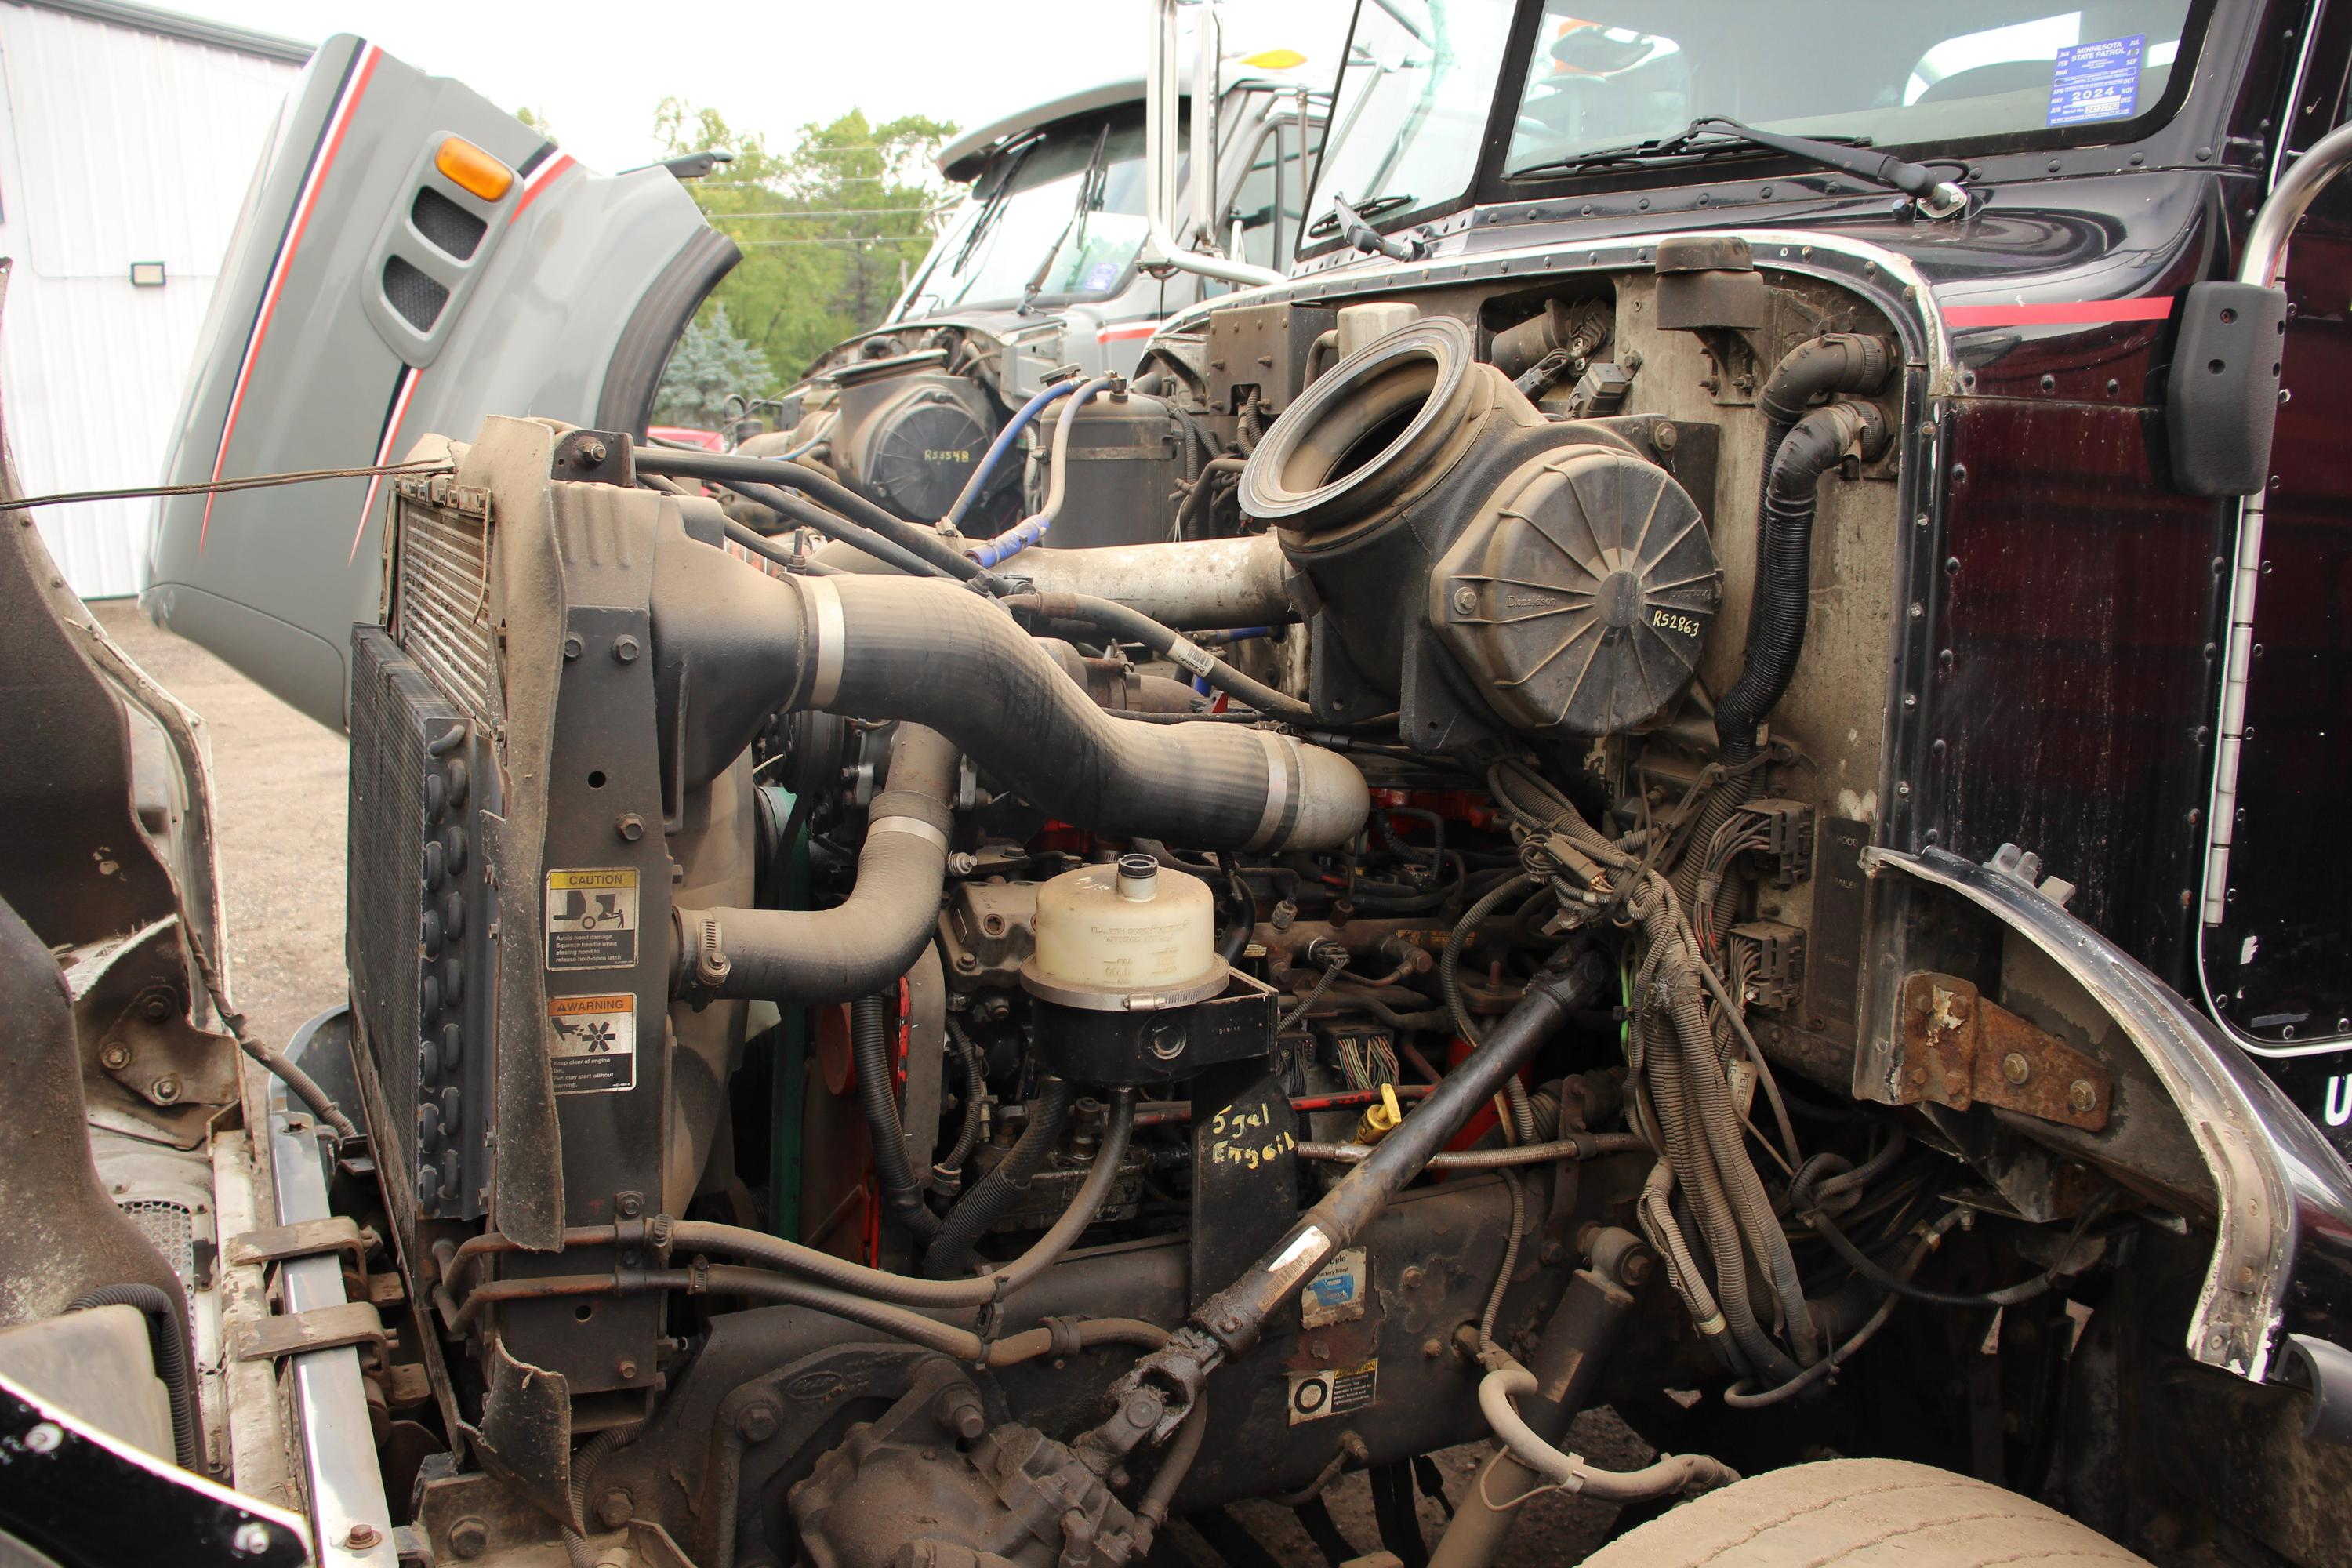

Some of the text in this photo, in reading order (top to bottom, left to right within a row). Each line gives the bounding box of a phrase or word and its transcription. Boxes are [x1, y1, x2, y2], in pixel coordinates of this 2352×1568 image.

[2077, 42, 2122, 54] MINNESOTA
[2071, 48, 2125, 62] STATE PATROL
[2071, 86, 2114, 101] 2024
[1506, 595, 1556, 608] Donaldson
[1837, 836, 1858, 847] HOOD
[569, 874, 622, 885] CAUTION
[568, 1000, 624, 1011] WARNING
[1728, 1063, 1737, 1091] 16-0
